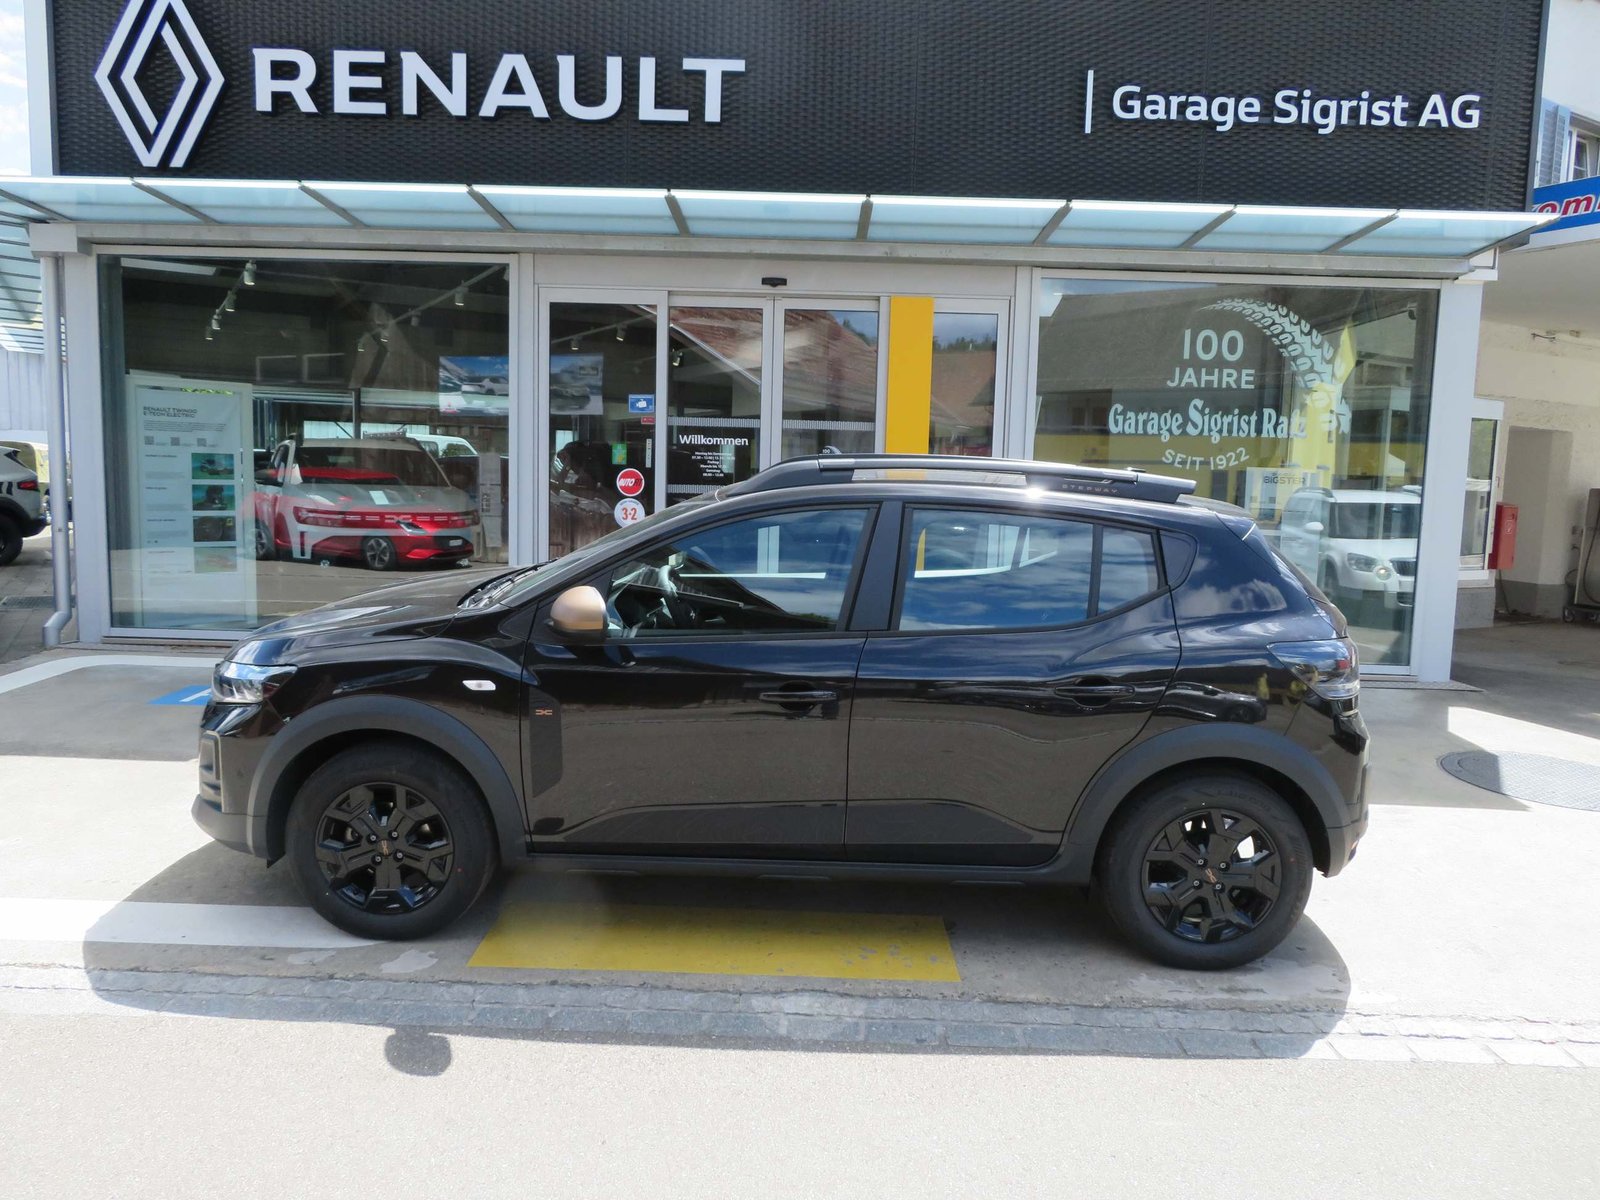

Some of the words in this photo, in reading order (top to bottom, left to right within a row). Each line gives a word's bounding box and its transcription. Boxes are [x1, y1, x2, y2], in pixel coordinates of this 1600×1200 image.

[253, 48, 746, 122] RENAULT
[1112, 85, 1261, 132] Garage
[1273, 89, 1409, 135] Sigrist
[1418, 94, 1481, 129] AG
[1183, 328, 1244, 361] 100
[1166, 367, 1255, 389] JAHRE
[1108, 403, 1183, 443] Garage
[1185, 398, 1258, 444] Sigrist
[679, 434, 749, 446] Willkommen
[1161, 449, 1205, 471] SEIT
[1209, 447, 1250, 471] 1922
